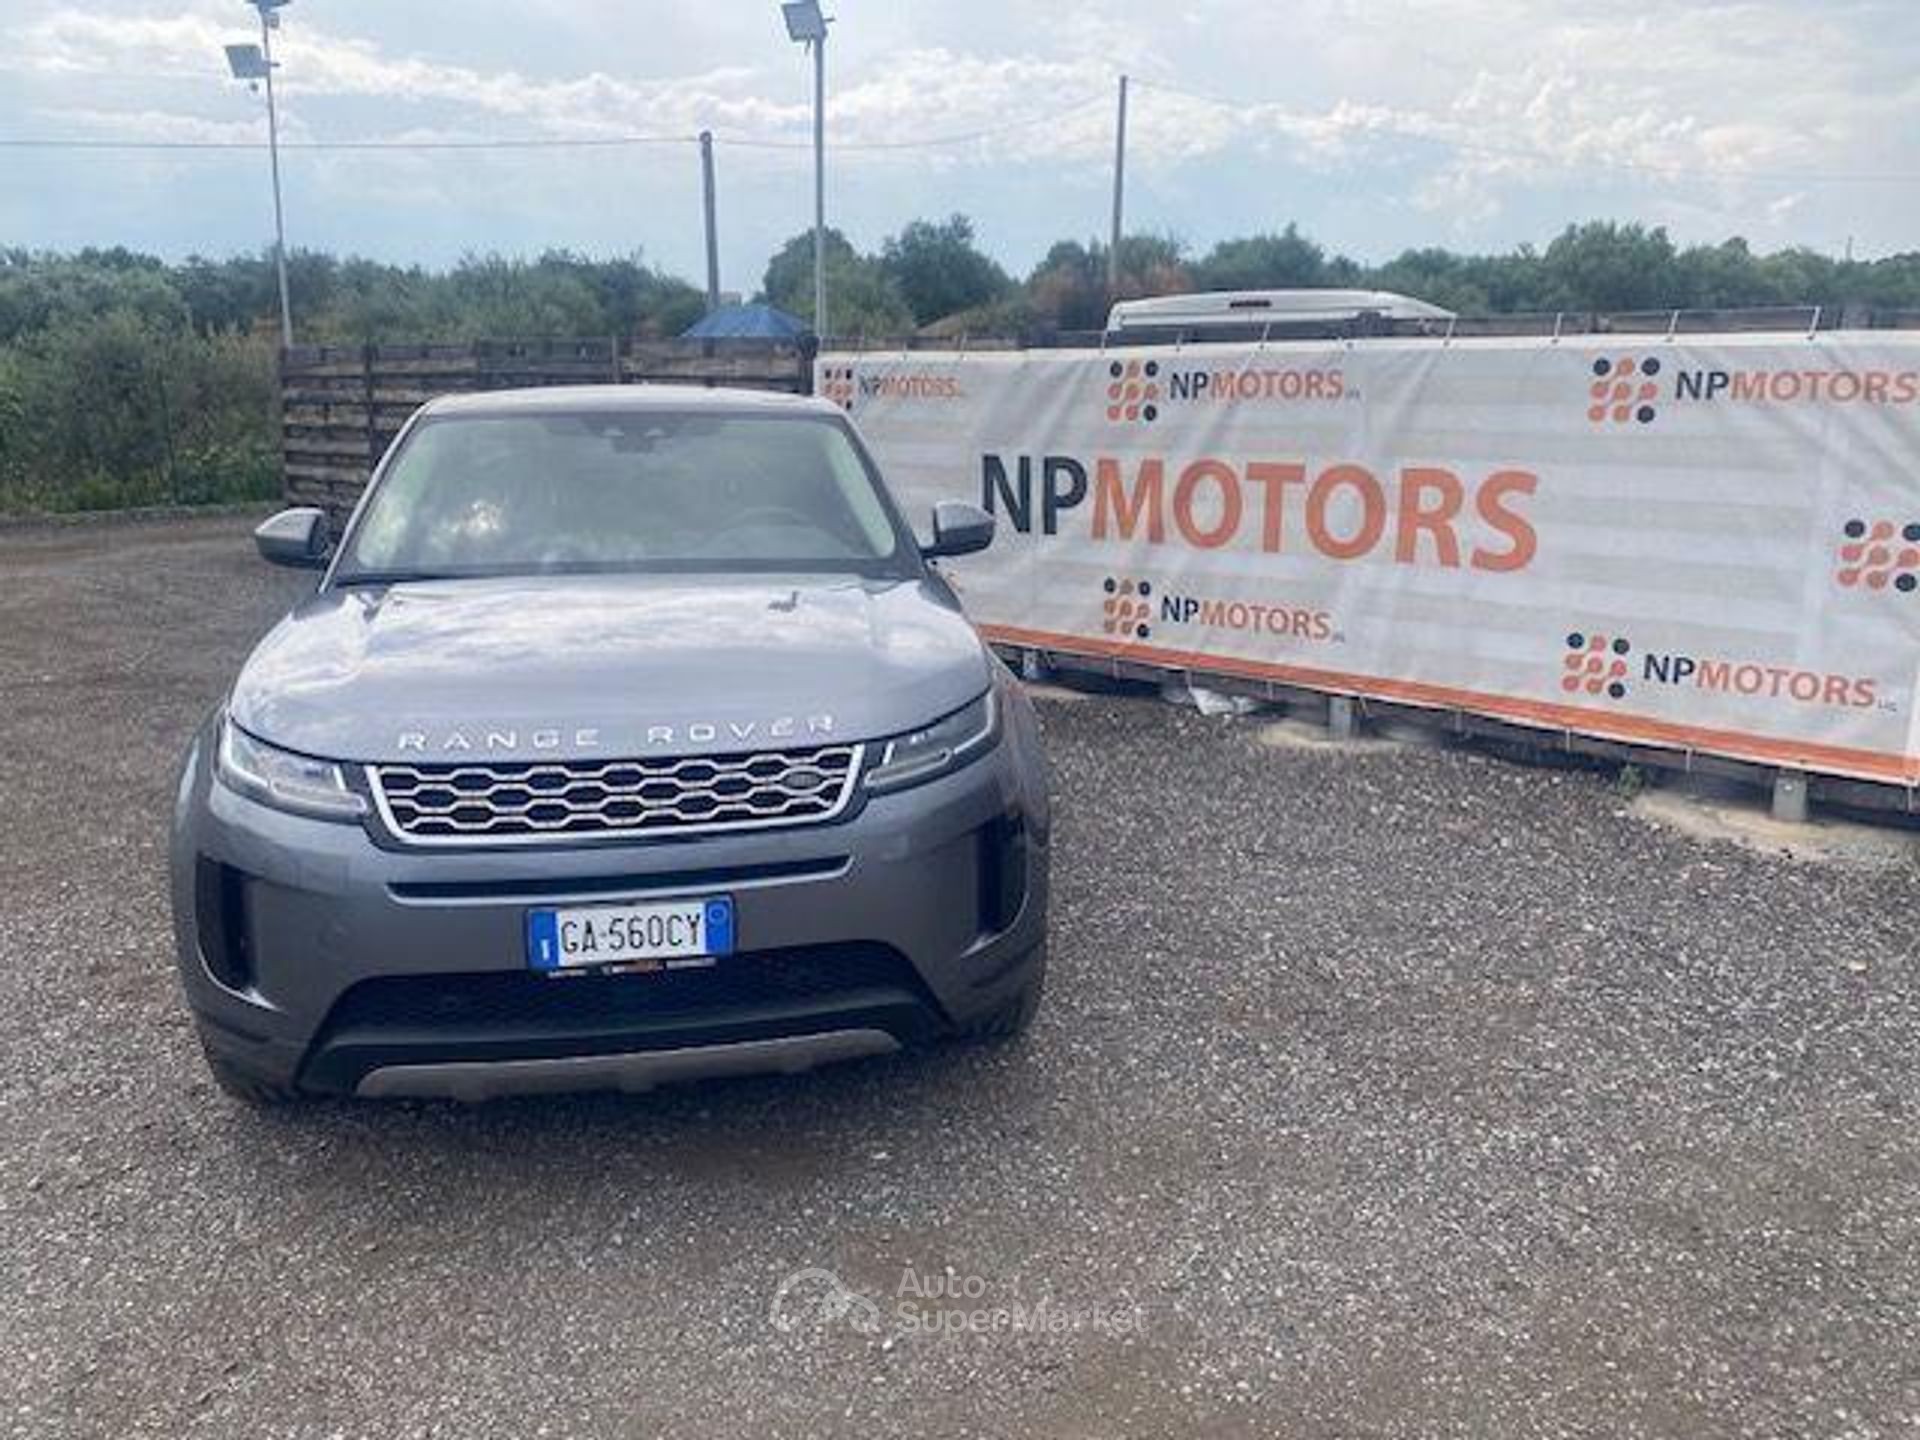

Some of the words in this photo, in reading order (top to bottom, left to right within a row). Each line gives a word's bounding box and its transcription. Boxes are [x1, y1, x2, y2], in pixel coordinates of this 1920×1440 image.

[858, 375, 960, 398] NPMOTORS
[1170, 368, 1344, 400] NPMOTORS
[1675, 370, 1918, 404] NPMOTORS
[981, 453, 1538, 572] NPMOTORS
[1161, 595, 1331, 640] NPMOTORS
[1643, 654, 1877, 707] NPMOTORS
[398, 728, 599, 752] RANGE
[647, 713, 835, 745] ROVER
